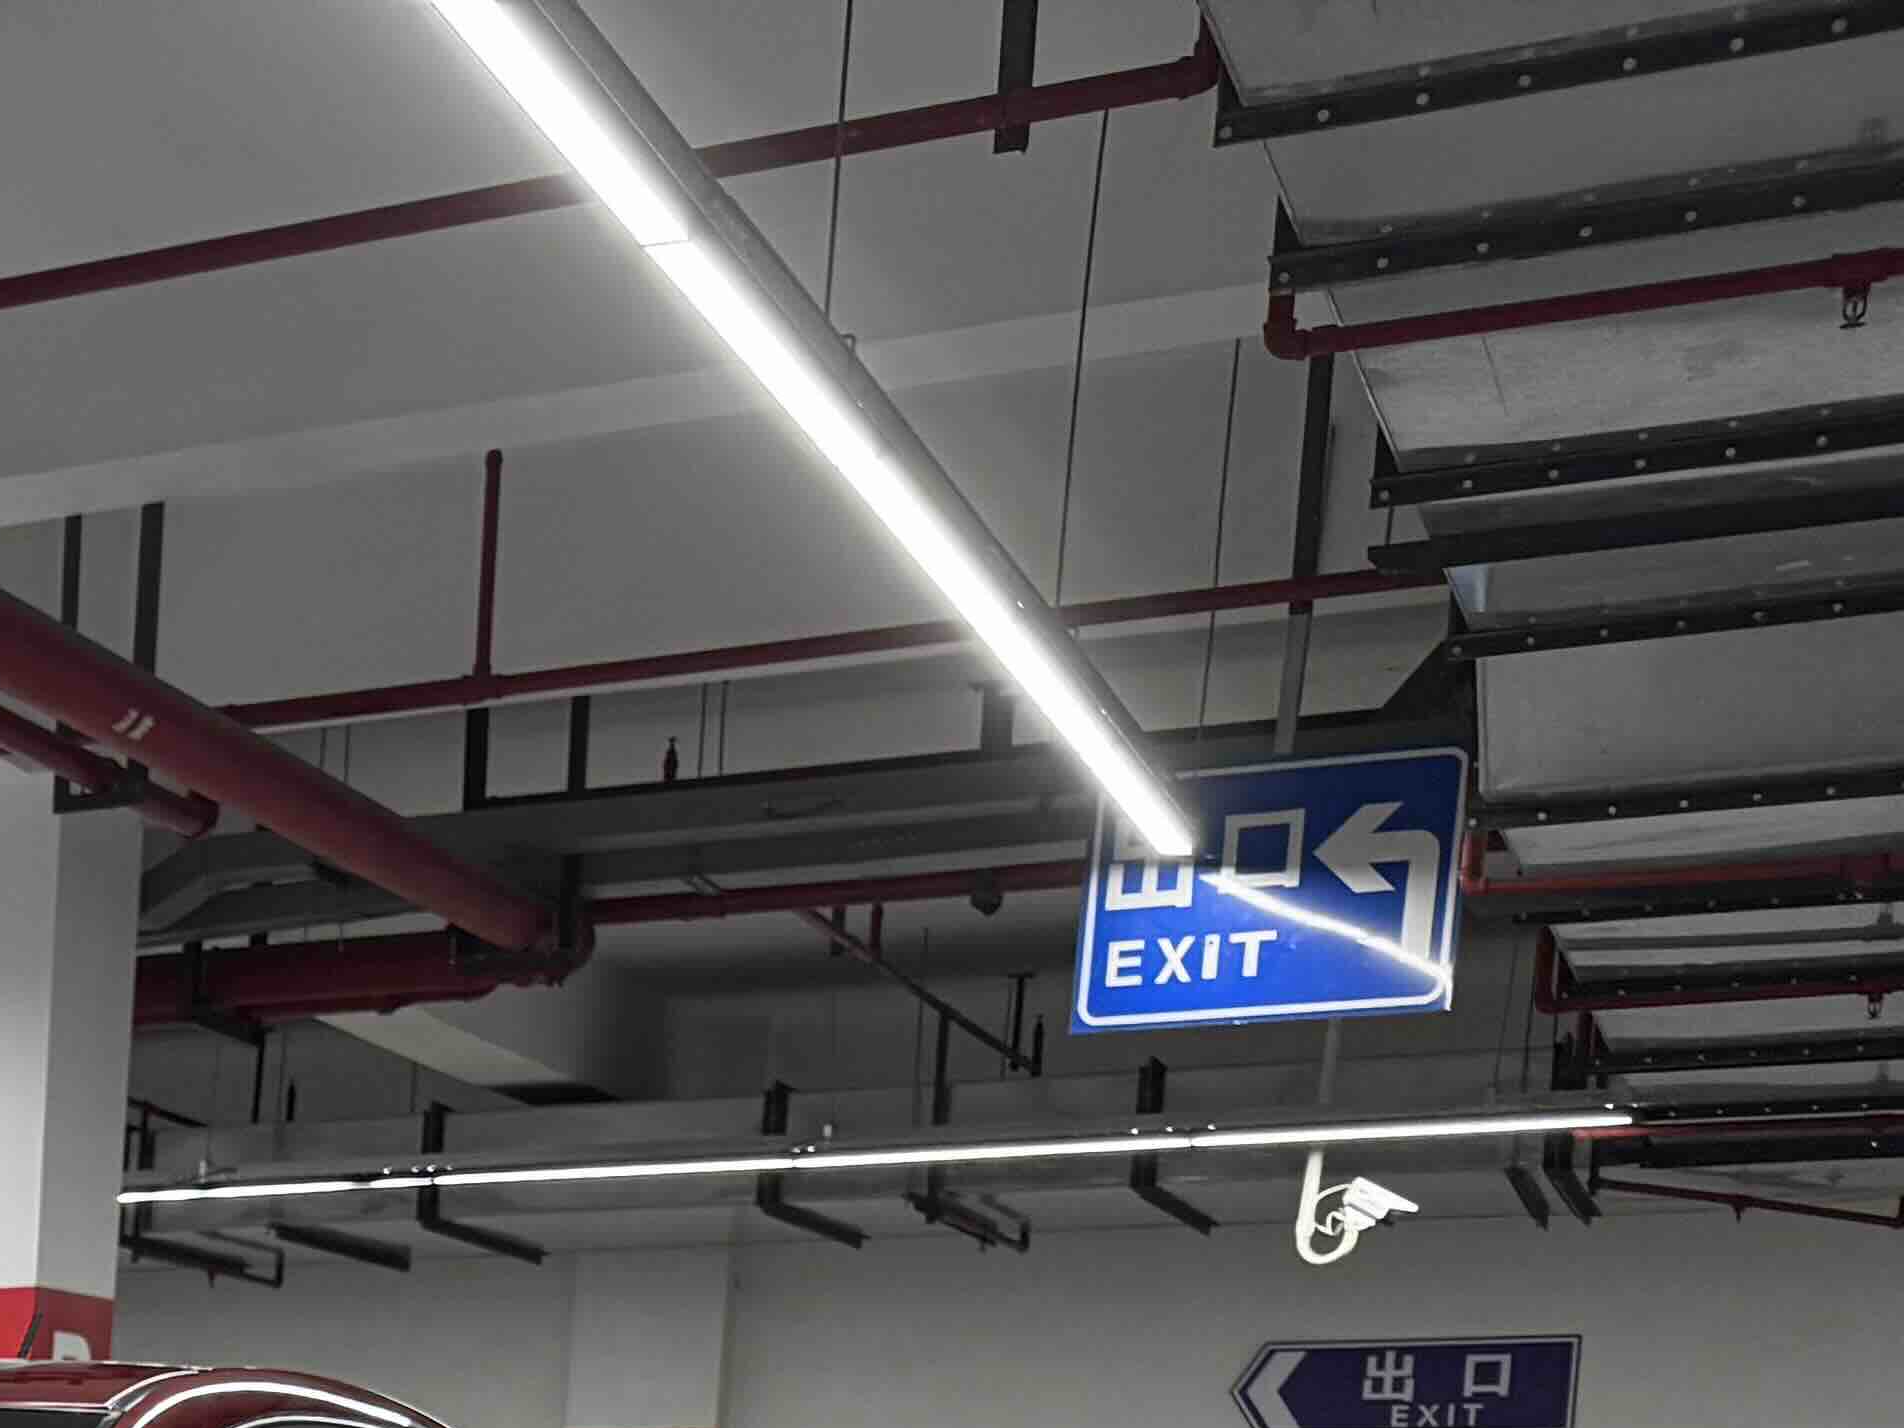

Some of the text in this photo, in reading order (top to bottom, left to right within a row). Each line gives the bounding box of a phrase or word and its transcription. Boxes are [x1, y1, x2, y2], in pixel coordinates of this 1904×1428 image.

[1105, 930, 1278, 988] EXIT
[1362, 1350, 1512, 1402] 出口
[1391, 1403, 1485, 1428] EXIT
